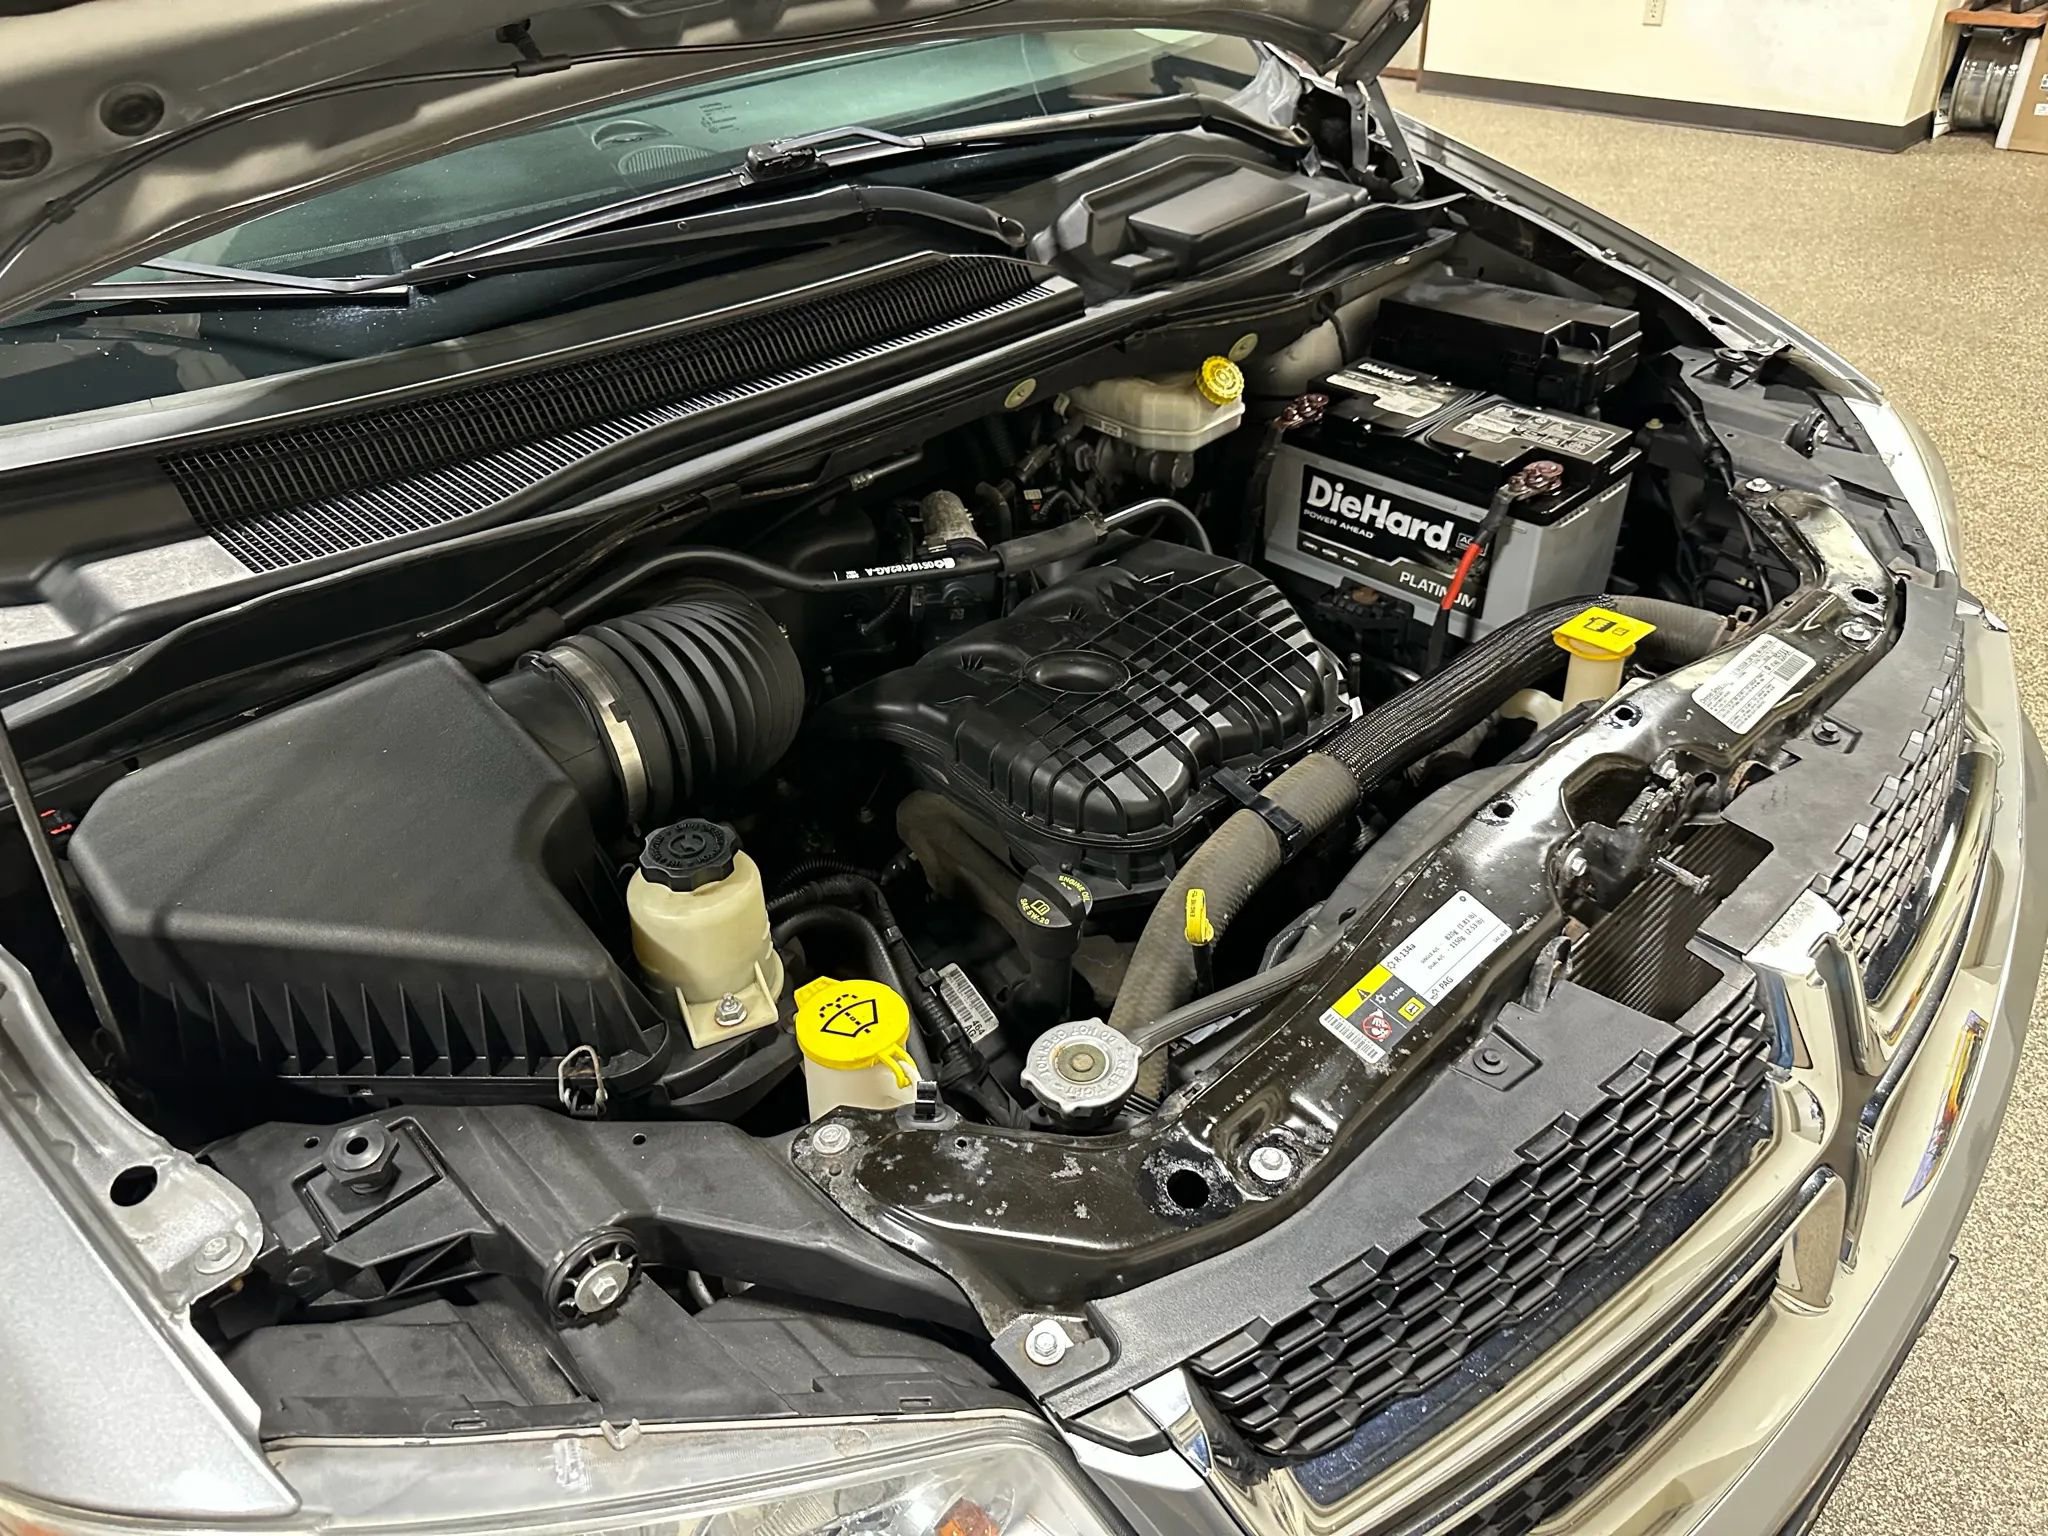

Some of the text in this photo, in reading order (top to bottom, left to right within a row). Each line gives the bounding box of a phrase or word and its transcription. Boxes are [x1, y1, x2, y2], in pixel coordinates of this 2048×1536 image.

[1303, 509, 1374, 539] POWER AHEAD
[1307, 475, 1454, 551] DieHard
[1059, 875, 1090, 902] ENGINE OIL
[1020, 898, 1050, 925] SAE 5W-20
[1394, 943, 1417, 963] R-134a
[1438, 976, 1454, 990] PAG
[965, 1025, 977, 1037] AG
[973, 1020, 986, 1036] 464
